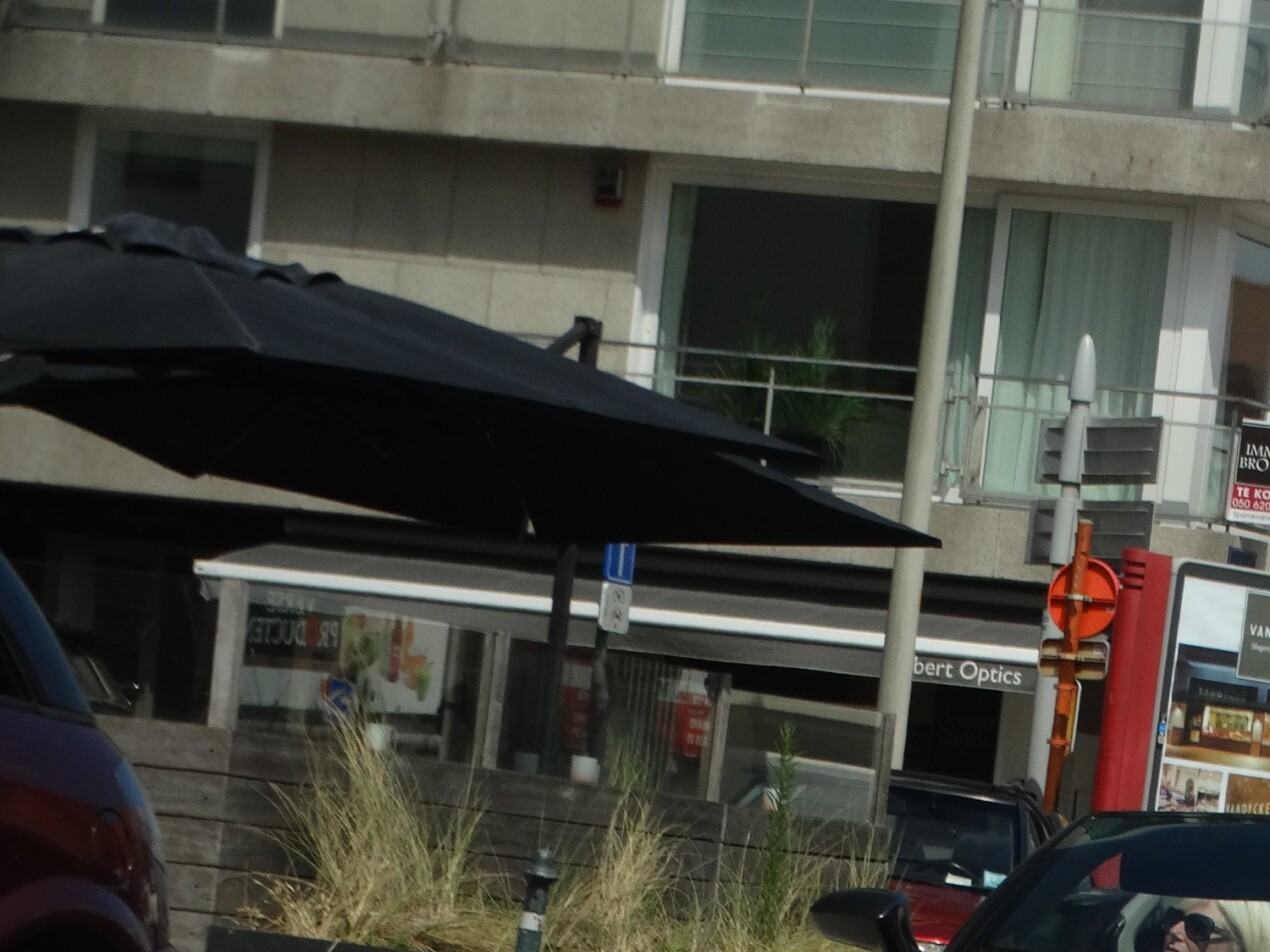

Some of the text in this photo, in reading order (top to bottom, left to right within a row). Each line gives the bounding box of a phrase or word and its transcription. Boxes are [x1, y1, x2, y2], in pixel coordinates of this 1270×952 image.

[1237, 487, 1249, 498] TE
[1232, 498, 1251, 508] 050
[1253, 501, 1270, 511] 620
[913, 657, 1023, 686] bert Optics
